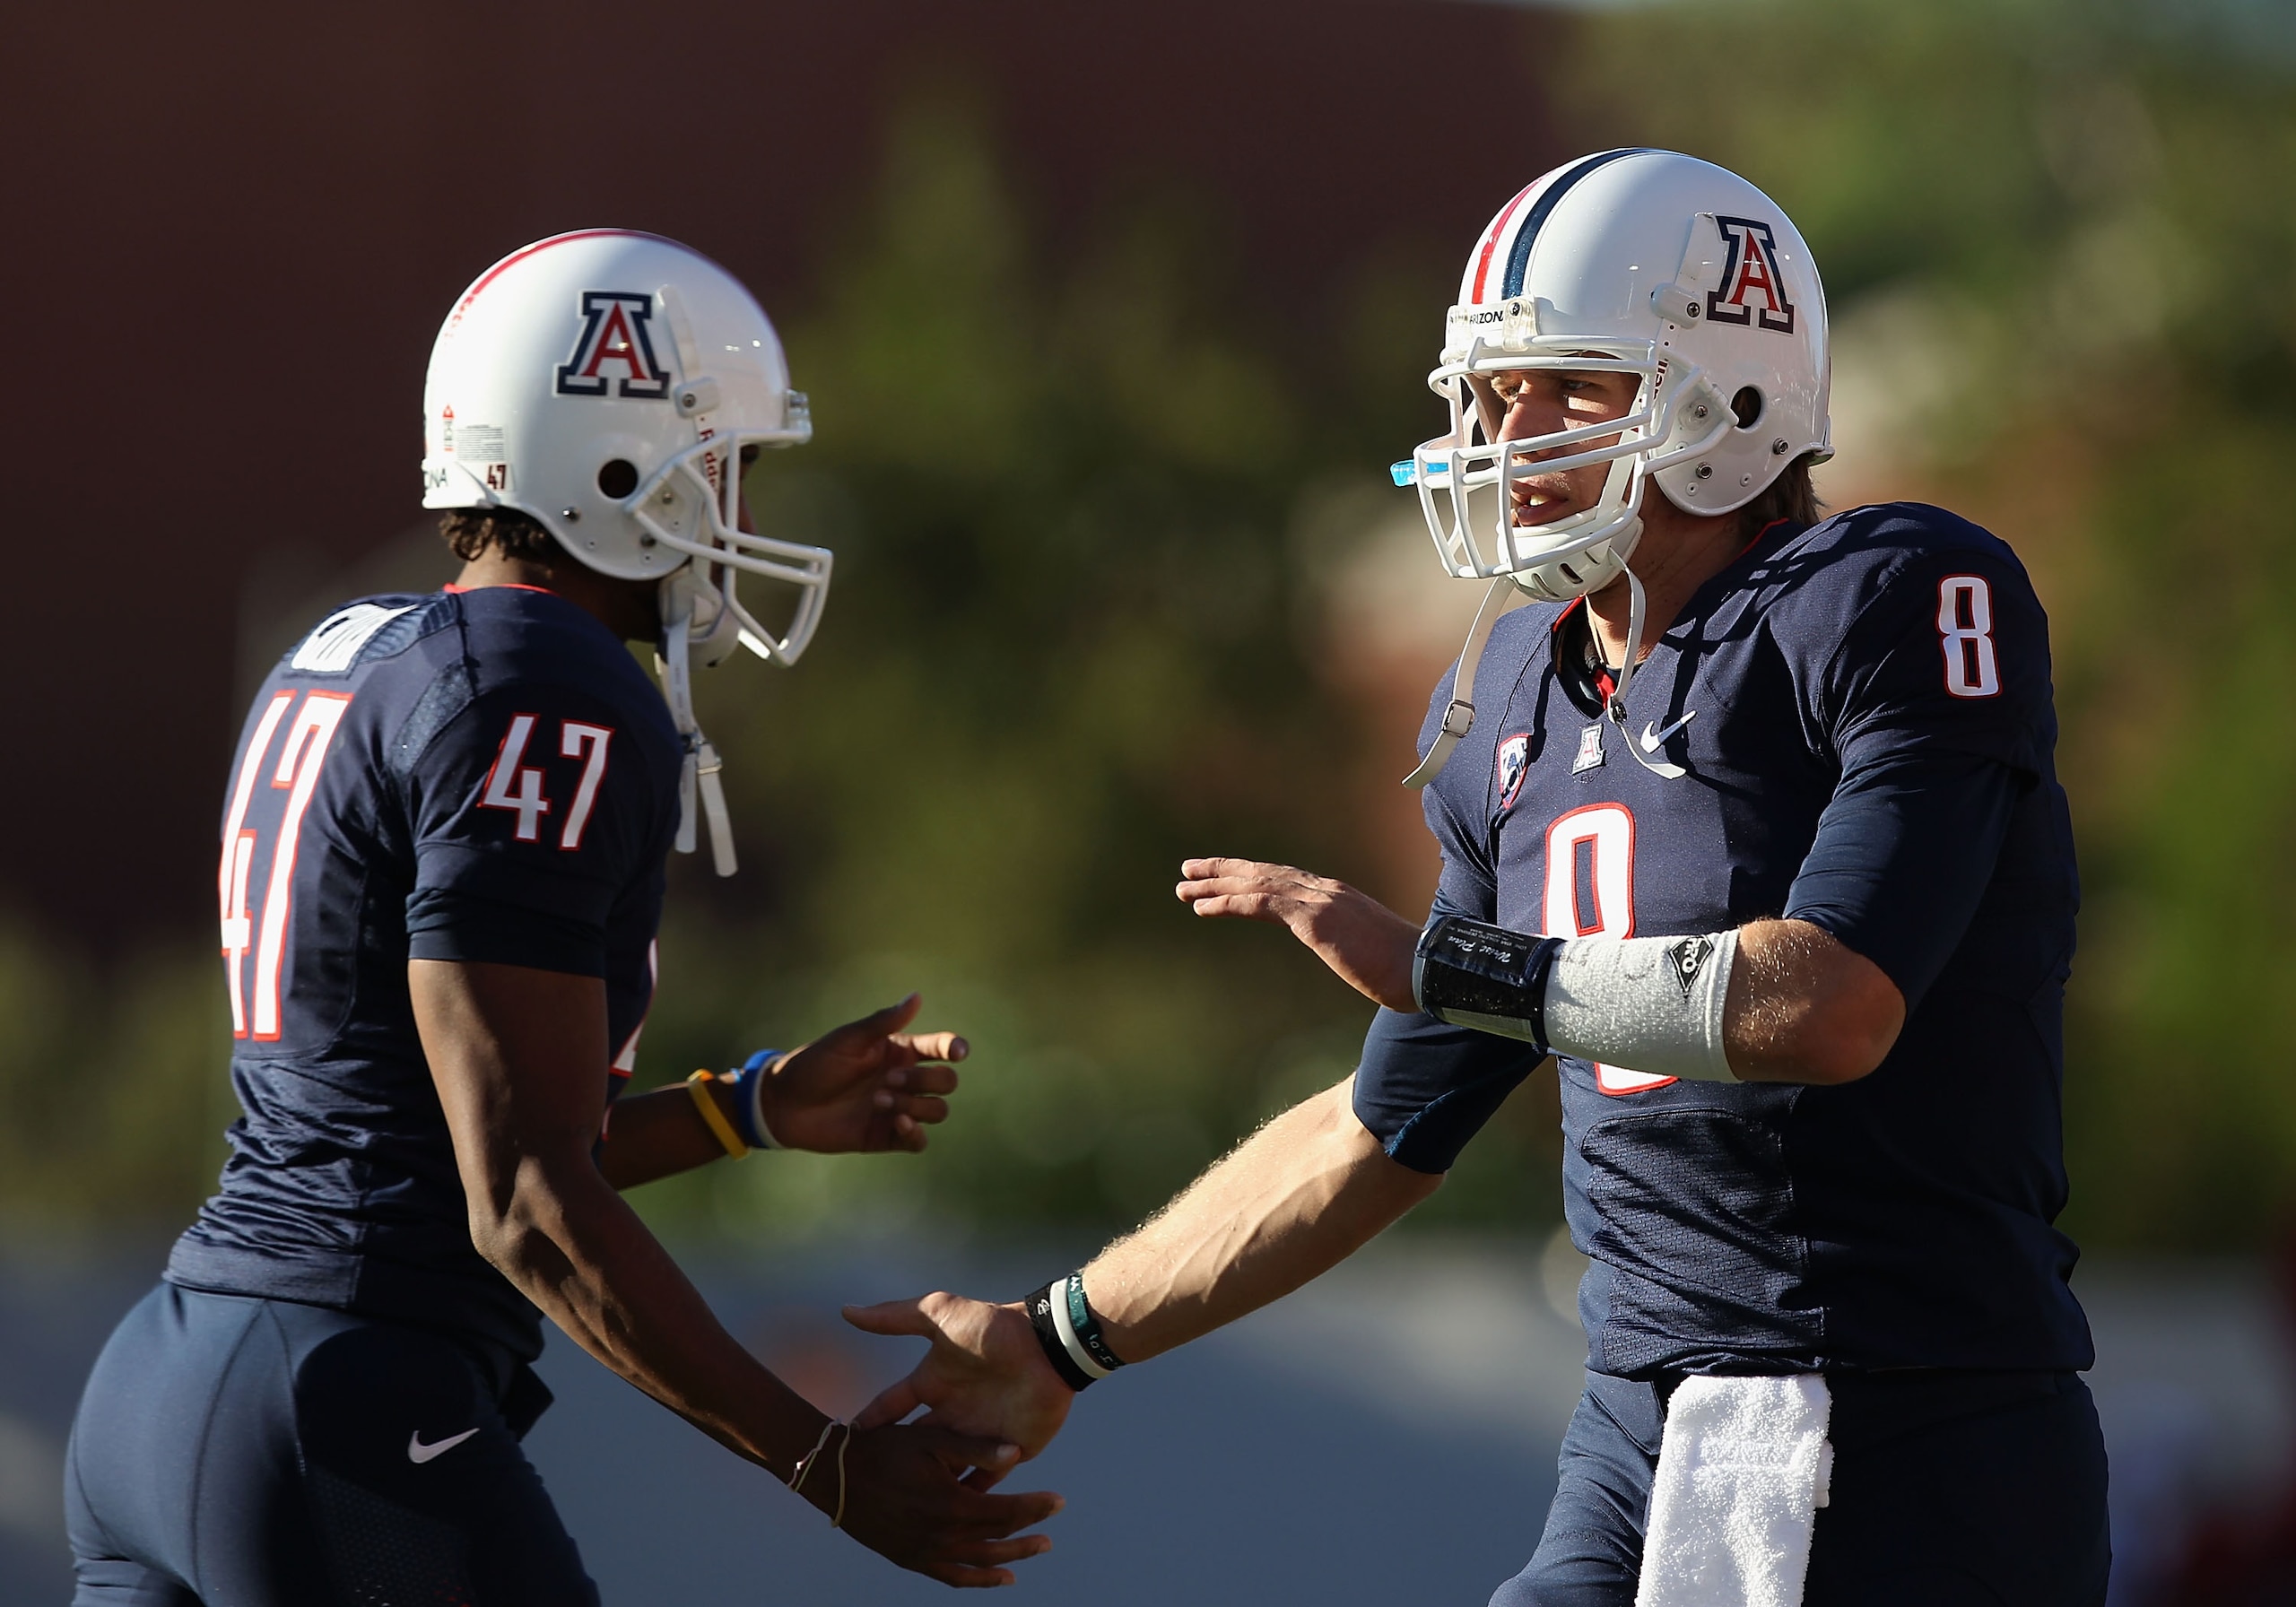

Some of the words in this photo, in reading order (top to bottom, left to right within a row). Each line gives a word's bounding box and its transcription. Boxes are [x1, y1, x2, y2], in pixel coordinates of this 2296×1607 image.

[1707, 214, 1795, 334] A
[556, 291, 671, 399] A
[487, 465, 507, 490] 47
[1934, 573, 2004, 699] 8
[476, 712, 616, 851] 47
[1572, 723, 1606, 776] A
[219, 689, 354, 1042] 47
[1447, 935, 1476, 952] Plan
[1479, 944, 1511, 963] Wrist
[1682, 937, 1705, 974] PRO
